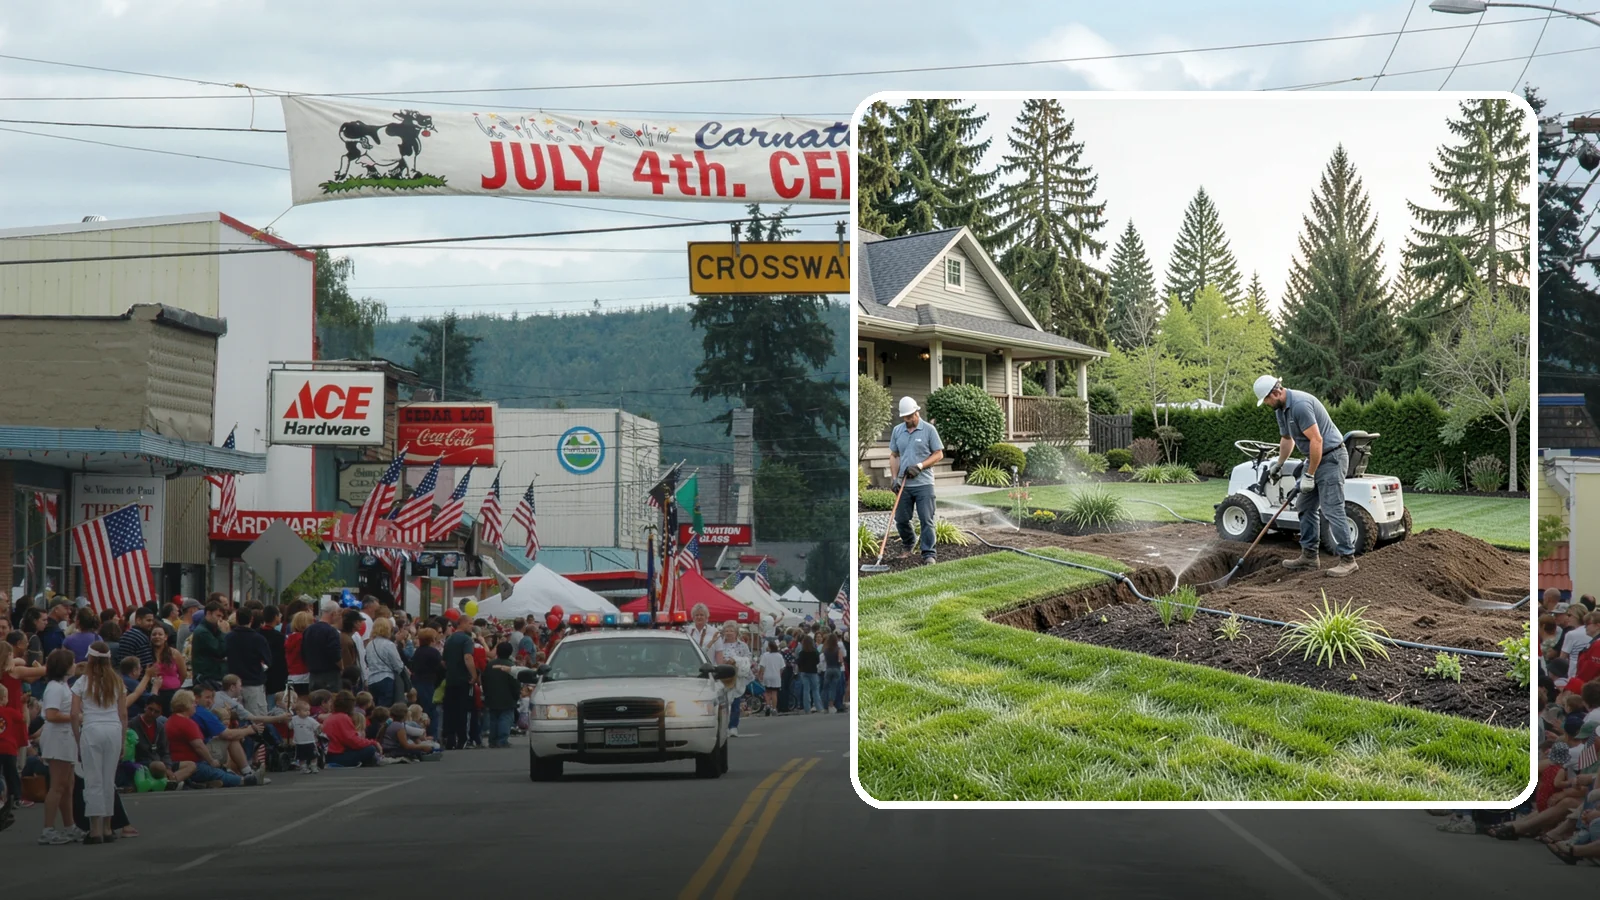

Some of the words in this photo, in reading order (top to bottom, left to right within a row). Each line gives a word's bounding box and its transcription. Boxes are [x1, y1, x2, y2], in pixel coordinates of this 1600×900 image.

[695, 121, 850, 150] Carnat
[481, 141, 605, 193] JULY
[632, 150, 746, 198] 4th.
[697, 254, 850, 280] CROSSWA
[283, 380, 373, 420] ACE
[405, 409, 452, 422] CEDAR
[283, 420, 371, 437] Hardware
[353, 467, 386, 480] Simpl
[83, 485, 93, 494] St.
[95, 485, 124, 494] Vincent
[126, 486, 136, 494] de
[137, 486, 155, 495] Paul
[81, 503, 153, 522] THT
[688, 526, 741, 535] CRNATION
[699, 535, 730, 543] GLASS
